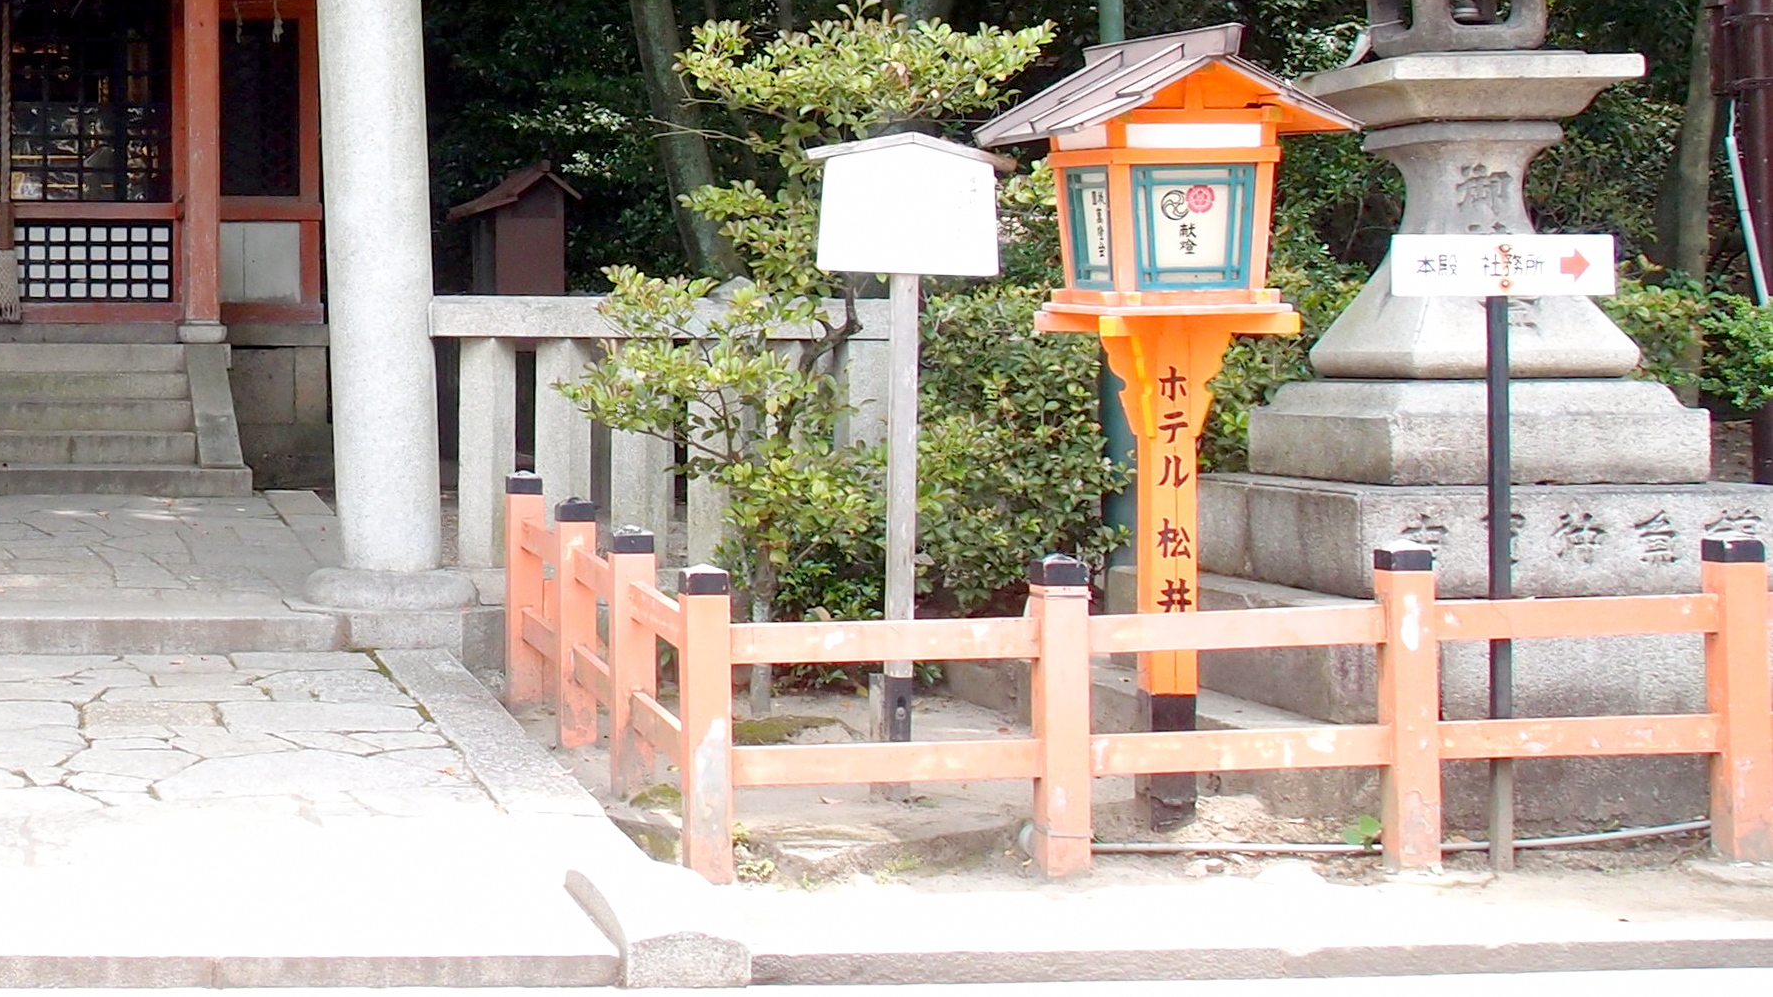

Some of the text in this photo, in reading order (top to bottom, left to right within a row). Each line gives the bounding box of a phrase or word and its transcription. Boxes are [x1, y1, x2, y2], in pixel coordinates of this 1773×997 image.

[1416, 254, 1545, 277] 本殿 社務所
